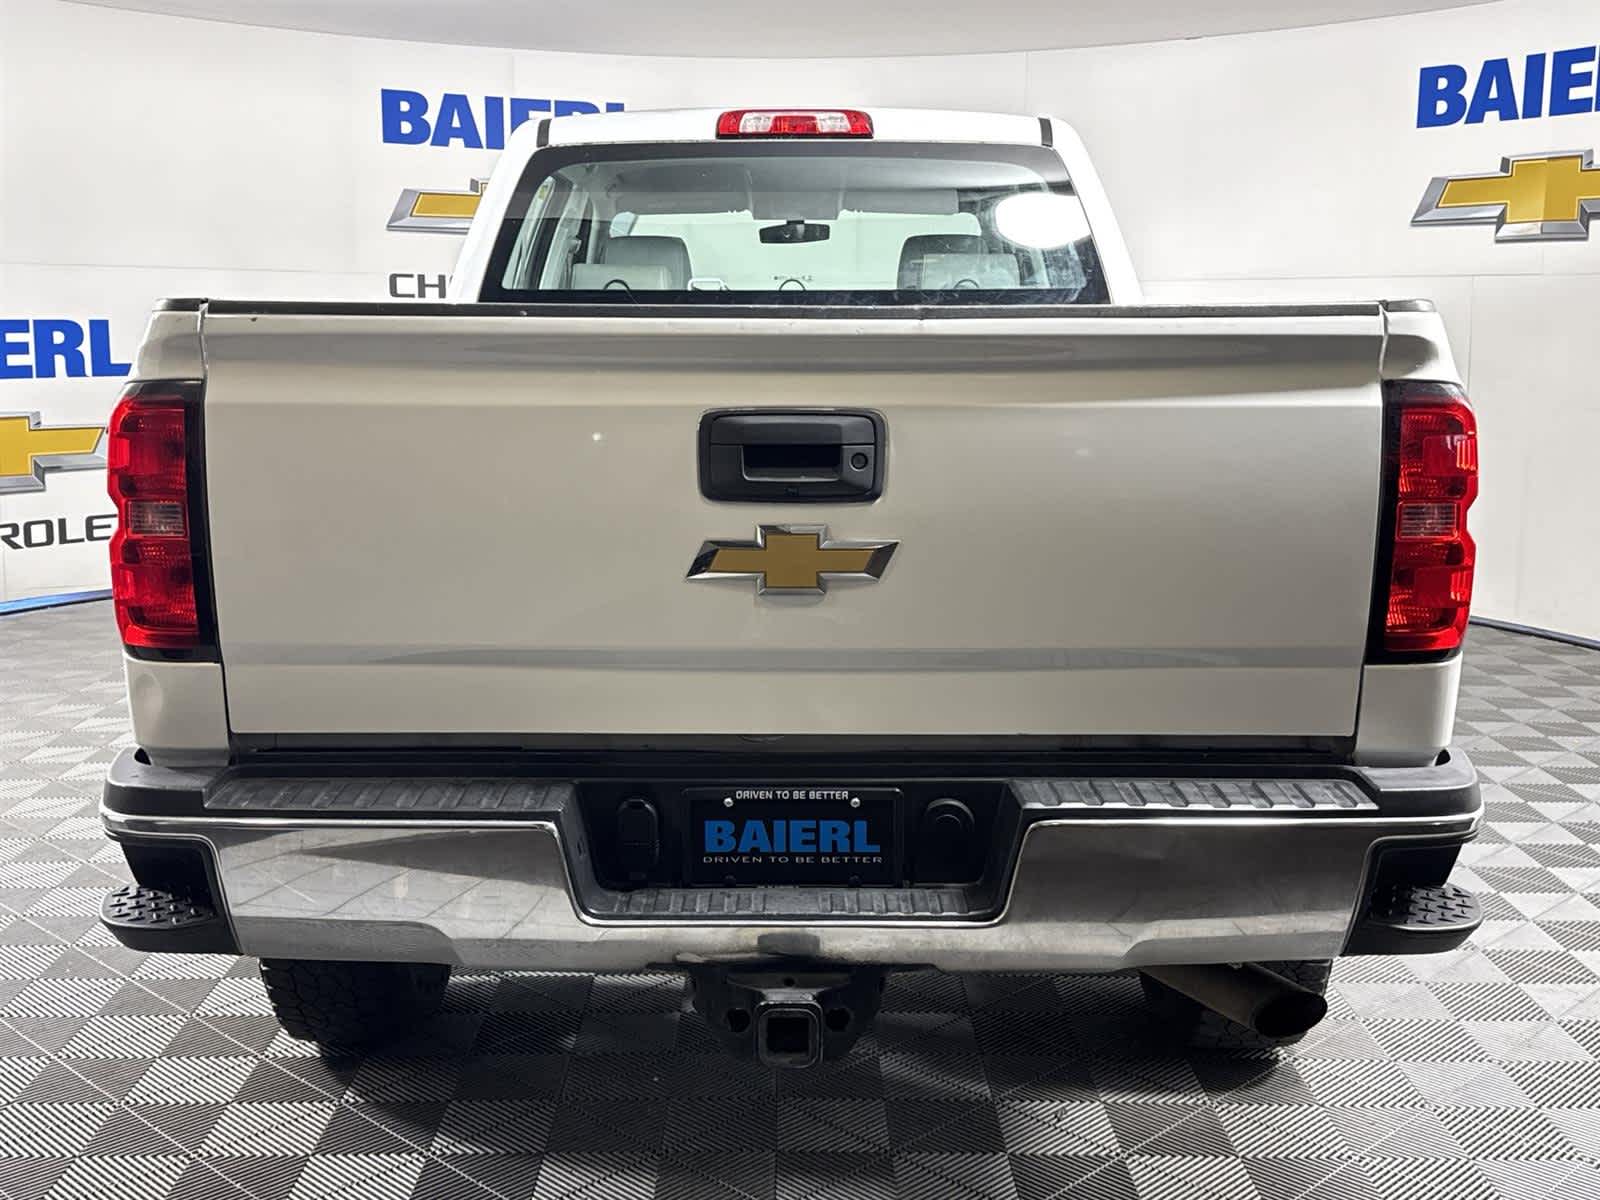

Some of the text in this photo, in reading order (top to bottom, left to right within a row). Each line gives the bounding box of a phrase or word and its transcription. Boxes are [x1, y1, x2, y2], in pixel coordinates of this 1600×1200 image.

[1416, 45, 1600, 129] BAIE
[380, 88, 625, 150] BAI
[735, 790, 849, 800] DRIVEN TO BE BETTER
[704, 819, 881, 854] BAIERL
[703, 855, 883, 864] DRIVEN TO BE BETTER
